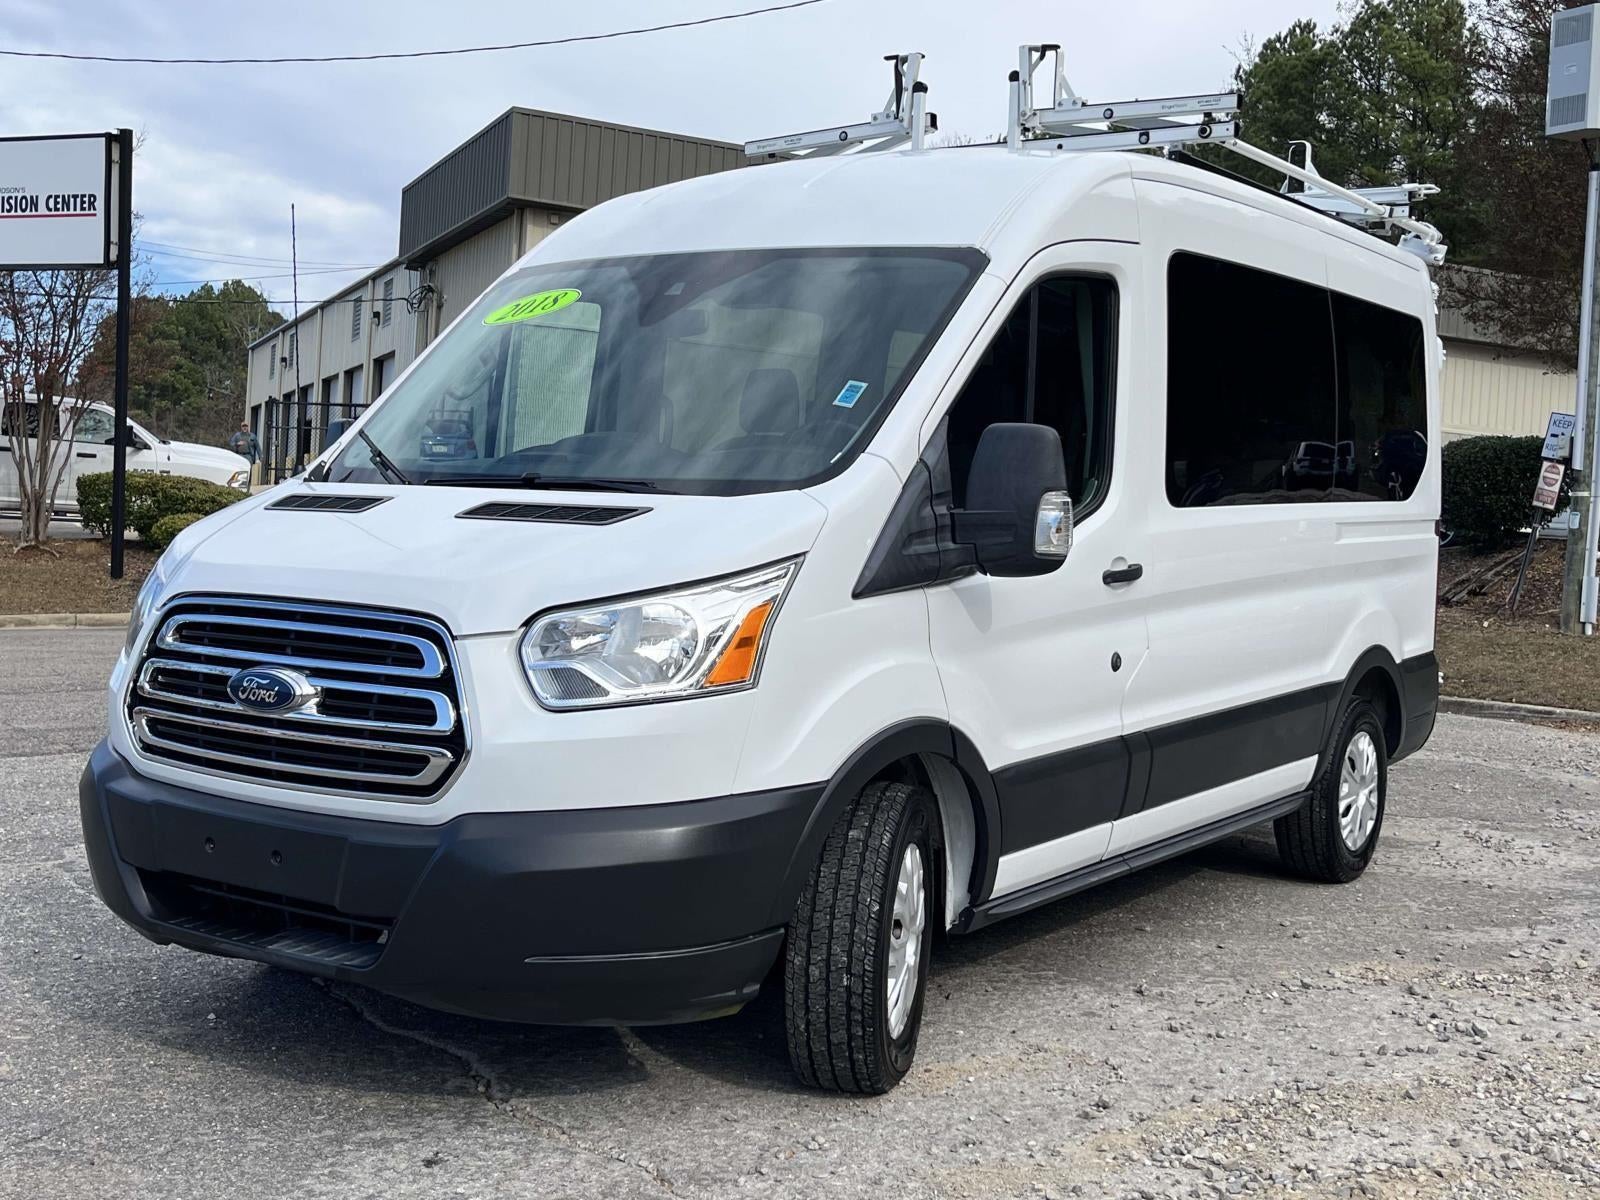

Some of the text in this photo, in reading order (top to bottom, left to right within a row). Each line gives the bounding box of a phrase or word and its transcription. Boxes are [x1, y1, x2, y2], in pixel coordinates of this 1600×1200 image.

[1, 193, 97, 214] ISION CENTER
[494, 291, 568, 322] 2018
[1552, 419, 1573, 429] KEEP
[238, 676, 280, 703] Ford
